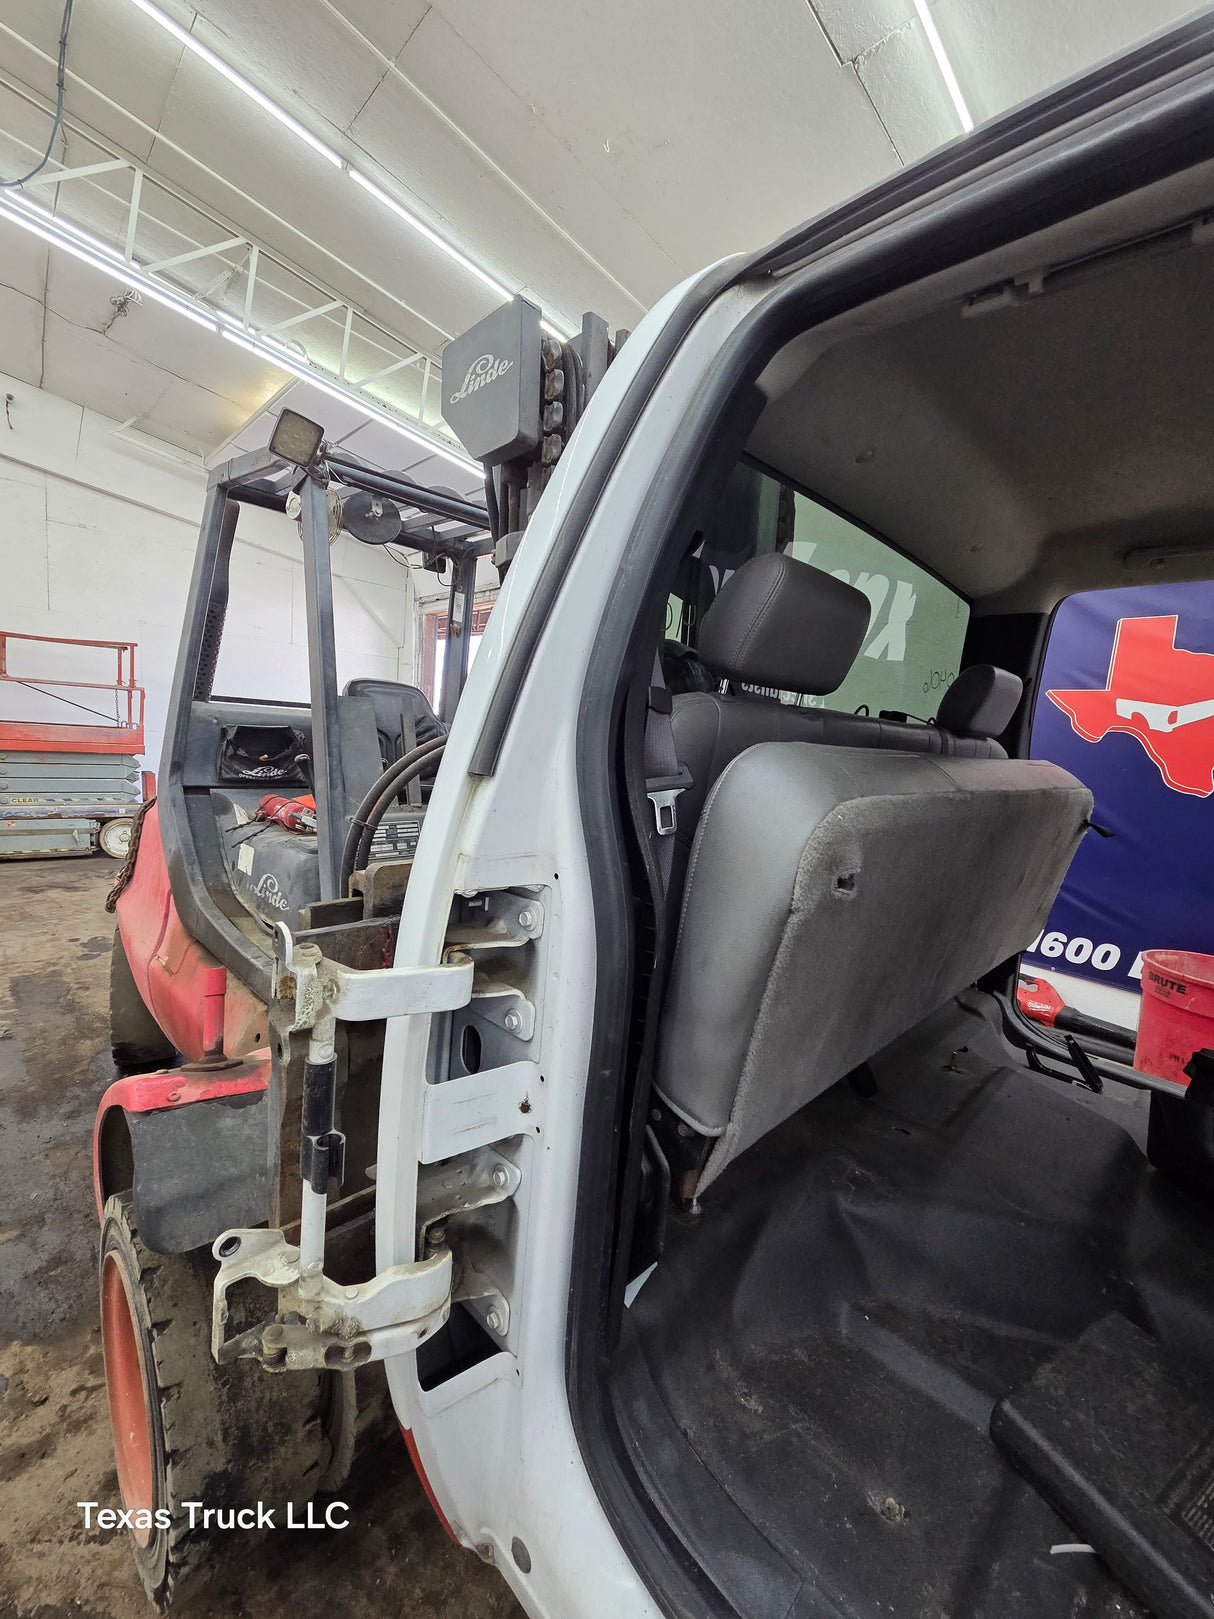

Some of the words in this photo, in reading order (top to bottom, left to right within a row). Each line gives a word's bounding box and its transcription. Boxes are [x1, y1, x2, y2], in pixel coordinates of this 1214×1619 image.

[450, 354, 513, 404] Linde
[242, 765, 287, 777] Linde
[250, 873, 291, 911] Linde
[1149, 971, 1187, 995] BRUTE
